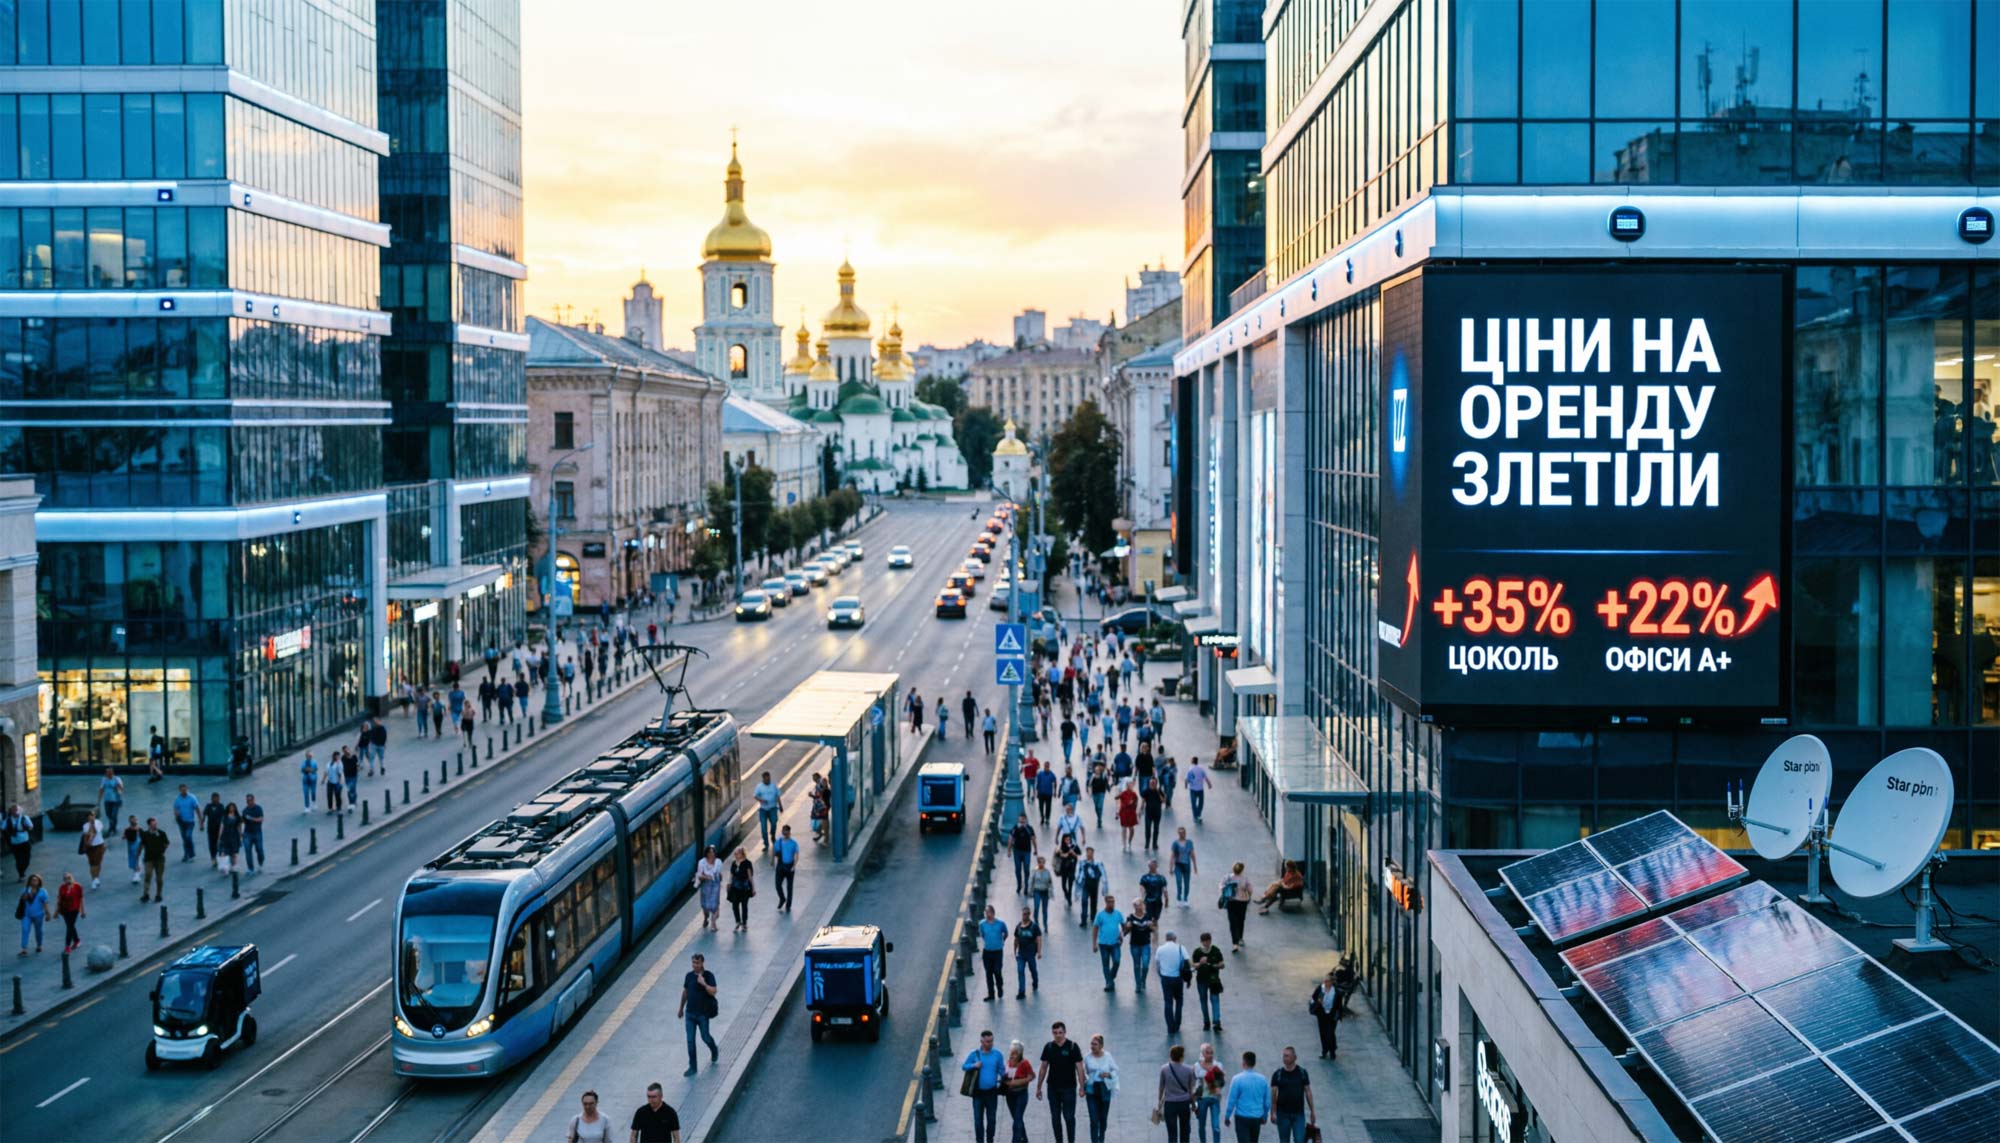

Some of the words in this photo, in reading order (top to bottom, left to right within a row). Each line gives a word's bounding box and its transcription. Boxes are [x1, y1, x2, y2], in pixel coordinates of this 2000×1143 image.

[1460, 317, 1612, 386] ЦІНИ
[1632, 317, 1722, 373] НА
[1460, 384, 1716, 451] ОРЕНДУ
[1451, 451, 1719, 507] ЗЛЕТІЛИ
[1432, 578, 1573, 635] +35%
[1596, 579, 1736, 636] +22%
[1448, 645, 1559, 675] ЦОКОЛЬ
[1605, 646, 1691, 672] ОФІСИ
[1784, 760, 1802, 772] Star
[1887, 776, 1911, 792] Star
